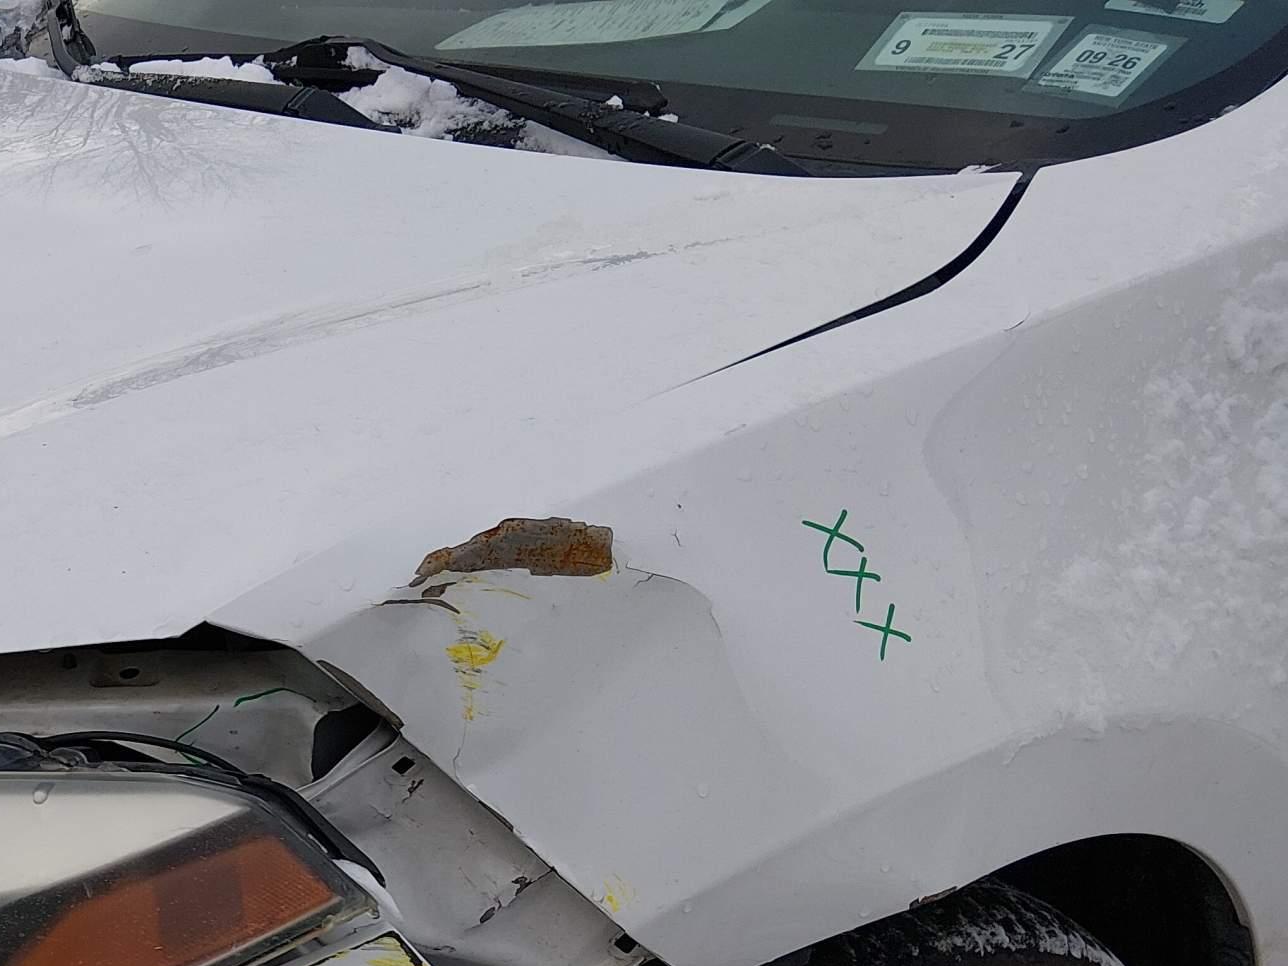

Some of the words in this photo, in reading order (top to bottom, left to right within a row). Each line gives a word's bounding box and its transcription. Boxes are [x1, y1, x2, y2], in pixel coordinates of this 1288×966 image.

[891, 39, 911, 55] 9
[992, 43, 1036, 60] 27
[1075, 49, 1107, 64] 09
[1108, 53, 1141, 70] 26
